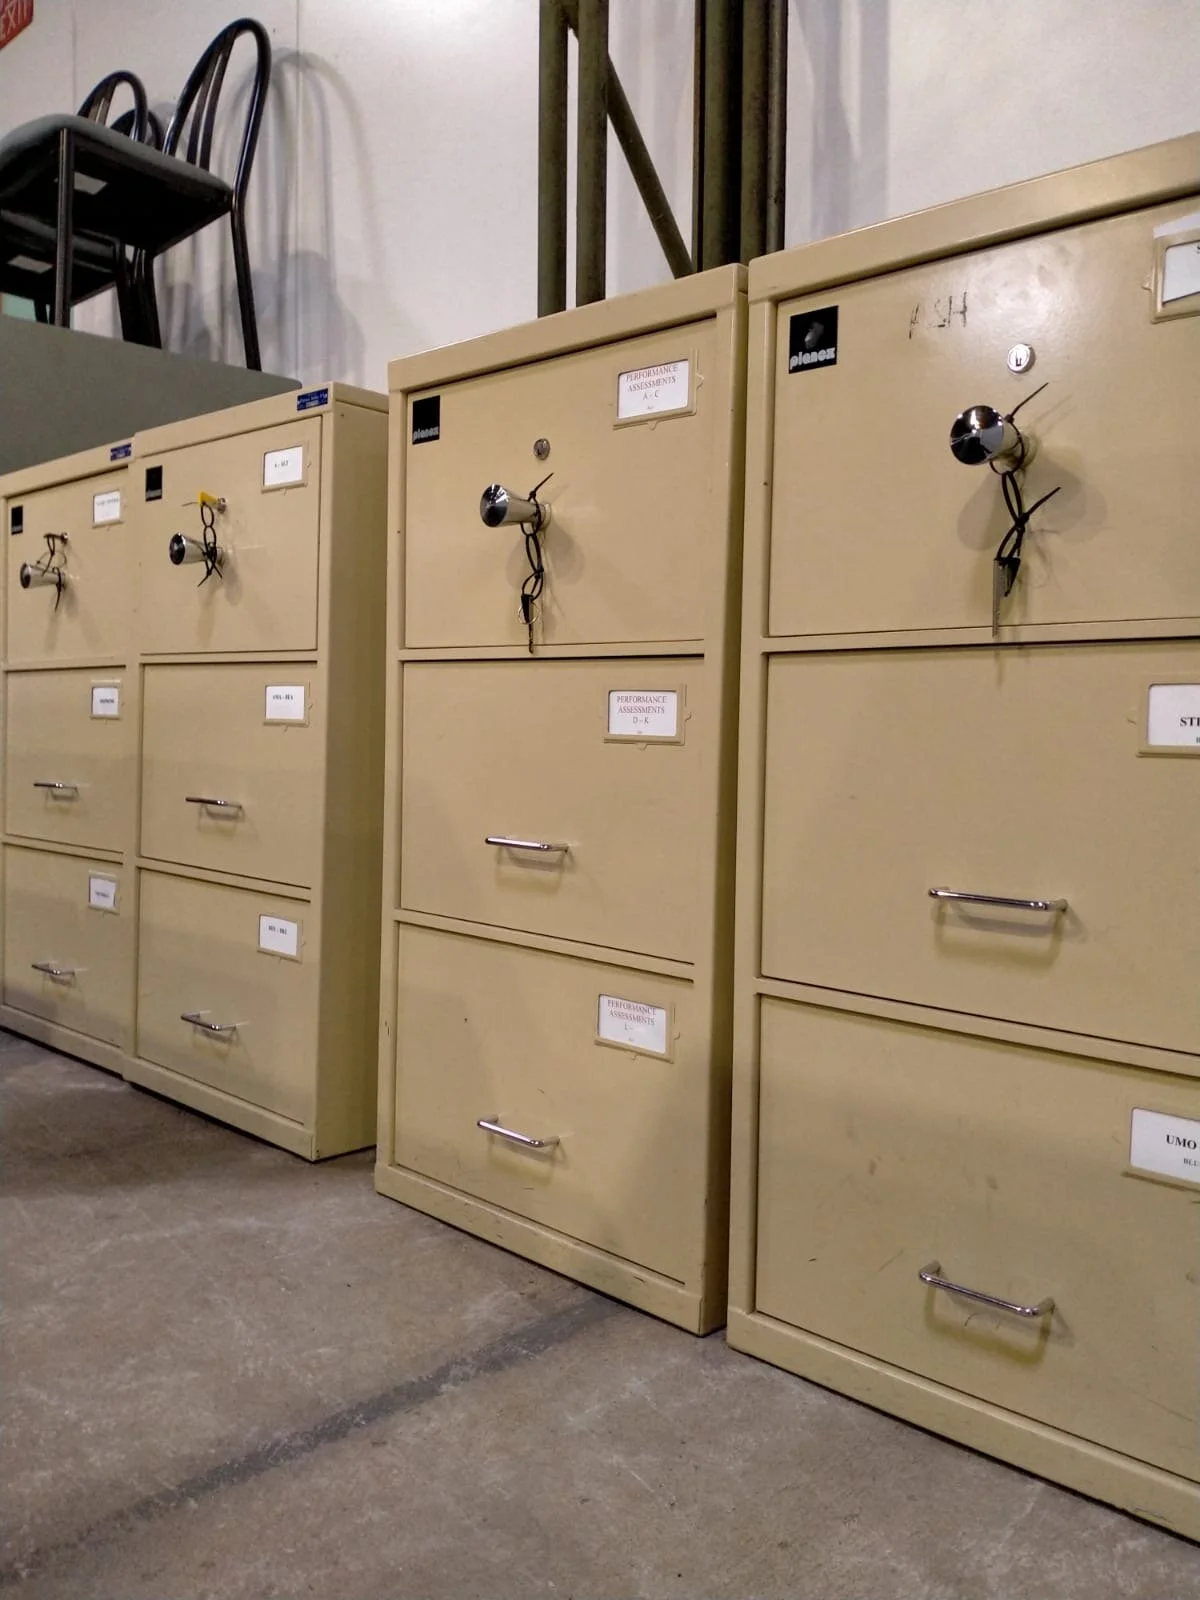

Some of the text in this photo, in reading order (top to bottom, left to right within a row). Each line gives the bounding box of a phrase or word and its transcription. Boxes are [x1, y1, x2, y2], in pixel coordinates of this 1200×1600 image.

[626, 364, 679, 382] PERFORMANCE
[628, 375, 676, 392] ASSESSMENTS
[616, 695, 668, 704] PERFORMANCE
[618, 705, 665, 714] ASSESSMENTS
[607, 999, 657, 1016] PERFORMANCE
[608, 1009, 655, 1026] ASSESSMENTS
[1166, 1134, 1197, 1150] UMO
